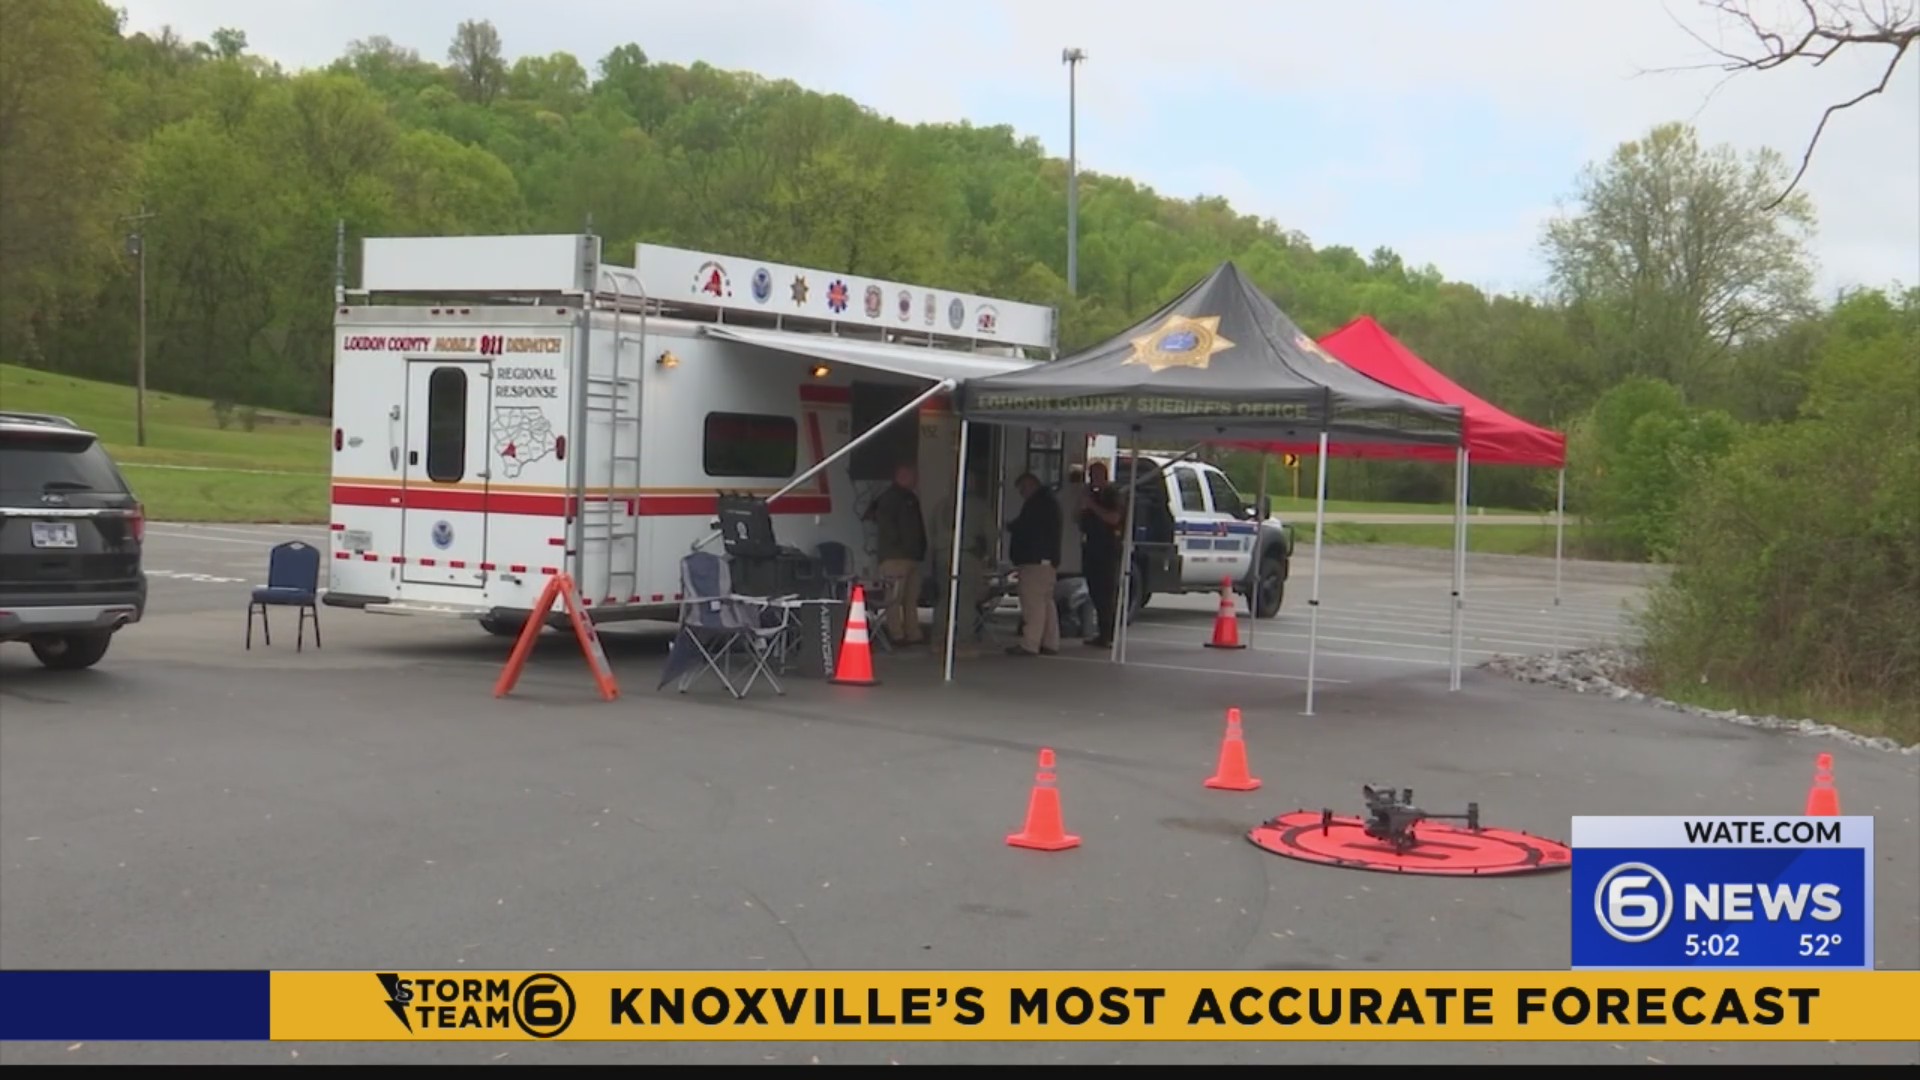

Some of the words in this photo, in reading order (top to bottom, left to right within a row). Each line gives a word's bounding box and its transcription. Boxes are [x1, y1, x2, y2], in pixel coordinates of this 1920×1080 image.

[344, 337, 386, 351] LOUDON
[388, 337, 431, 351] COUNTY
[434, 338, 477, 352] MOBILE
[479, 335, 504, 355] 911
[505, 338, 562, 353] DISPATCH
[497, 367, 557, 380] REGIONAL
[495, 386, 558, 398] RESPONSE
[1056, 396, 1132, 412] COUNTY
[1136, 396, 1233, 416] SHERIFF'S
[1237, 402, 1308, 419] OFFICE
